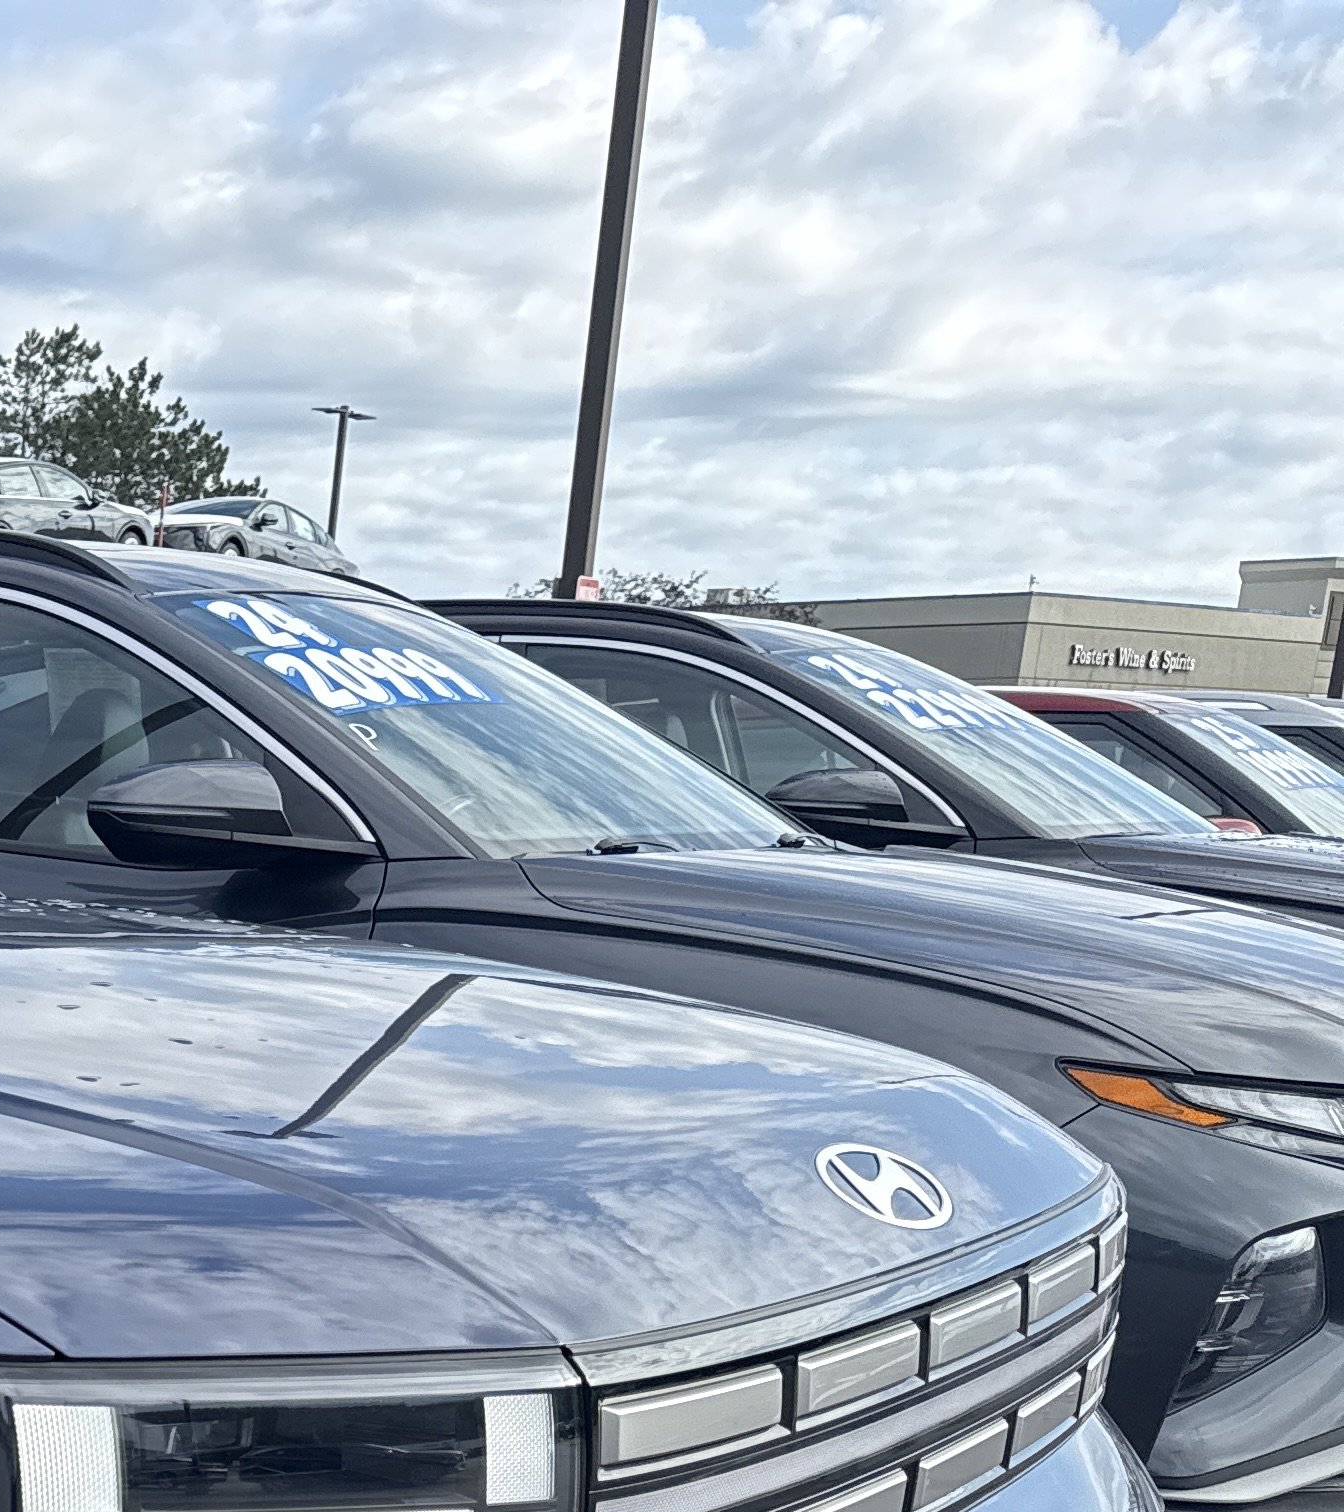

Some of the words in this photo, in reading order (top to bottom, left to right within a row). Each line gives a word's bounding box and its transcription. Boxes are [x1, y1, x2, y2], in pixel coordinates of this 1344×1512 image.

[207, 600, 338, 649] 24
[264, 648, 492, 709] 20999
[1071, 645, 1114, 666] Foster's
[1118, 647, 1146, 668] Wine
[1149, 649, 1160, 669] &
[1162, 650, 1196, 673] Spirits
[867, 689, 1027, 730] 22999
